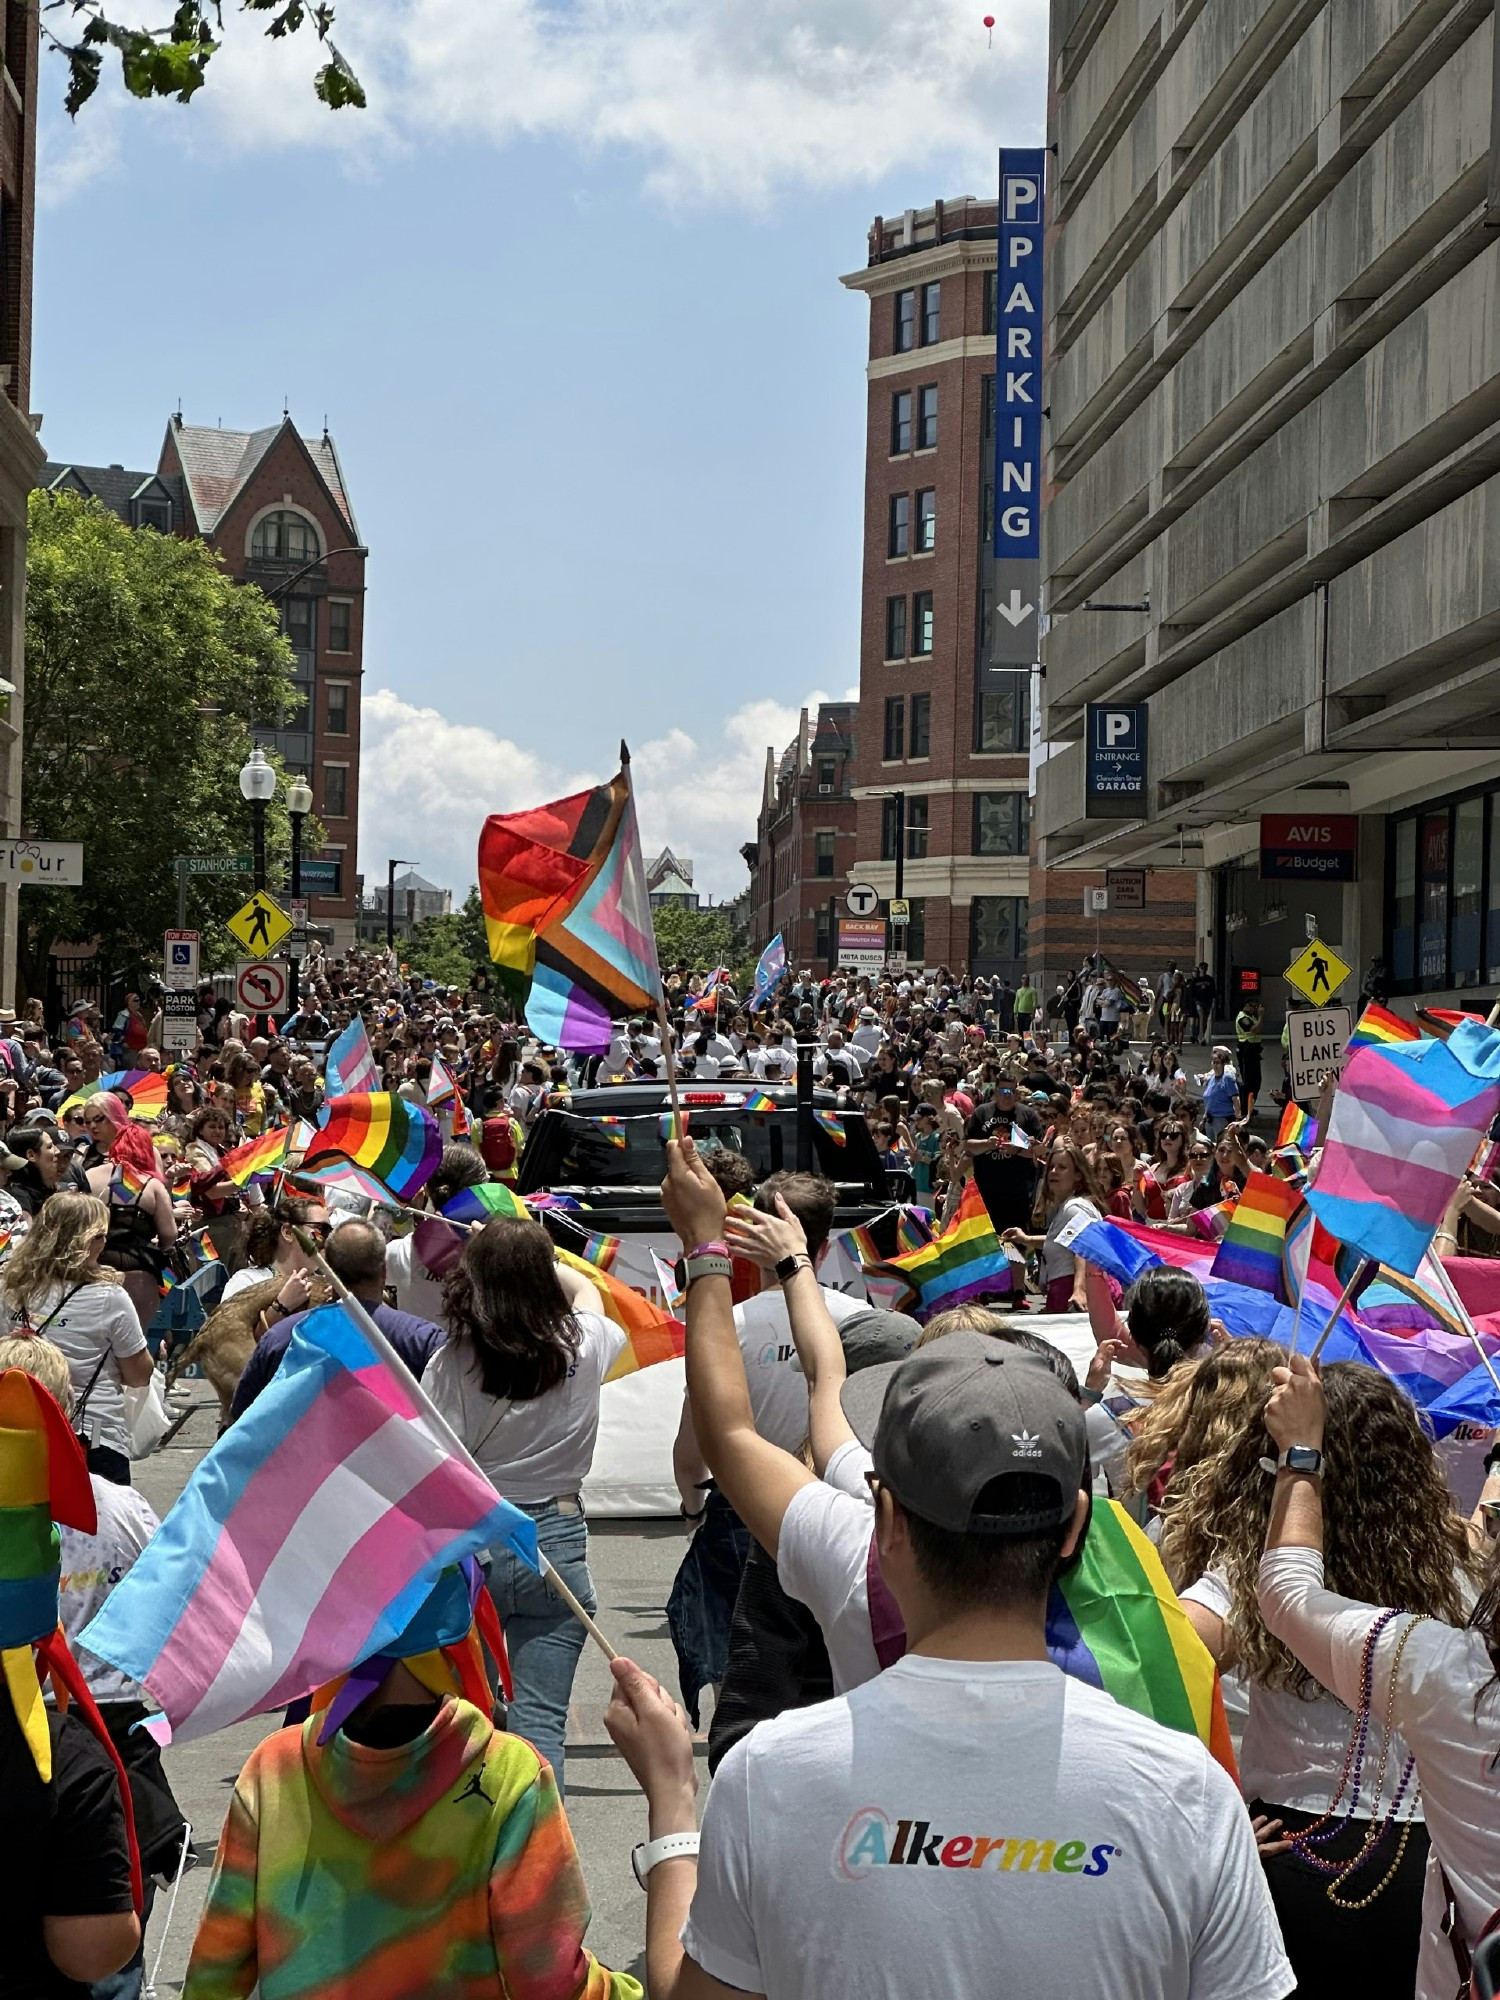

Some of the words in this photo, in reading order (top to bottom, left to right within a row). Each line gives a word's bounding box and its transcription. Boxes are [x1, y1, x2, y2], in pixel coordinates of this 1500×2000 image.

[1007, 178, 1037, 220] P
[1001, 236, 1035, 537] PARKING
[1106, 714, 1130, 745] P
[1095, 753, 1140, 761] ENTRANCE
[1096, 782, 1141, 790] GARAGE
[1286, 826, 1332, 842] AVIS
[189, 859, 238, 871] STANHOPE
[240, 862, 247, 870] ST
[1294, 857, 1339, 871] Budget
[852, 892, 872, 910] T
[168, 932, 180, 940] TOW
[181, 932, 197, 940] ZONE
[1422, 950, 1446, 976] GARAG
[165, 995, 195, 1005] PARK
[1303, 1020, 1336, 1038] BUS
[1301, 1043, 1342, 1062] LANE
[982, 1117, 1009, 1132] PROUD
